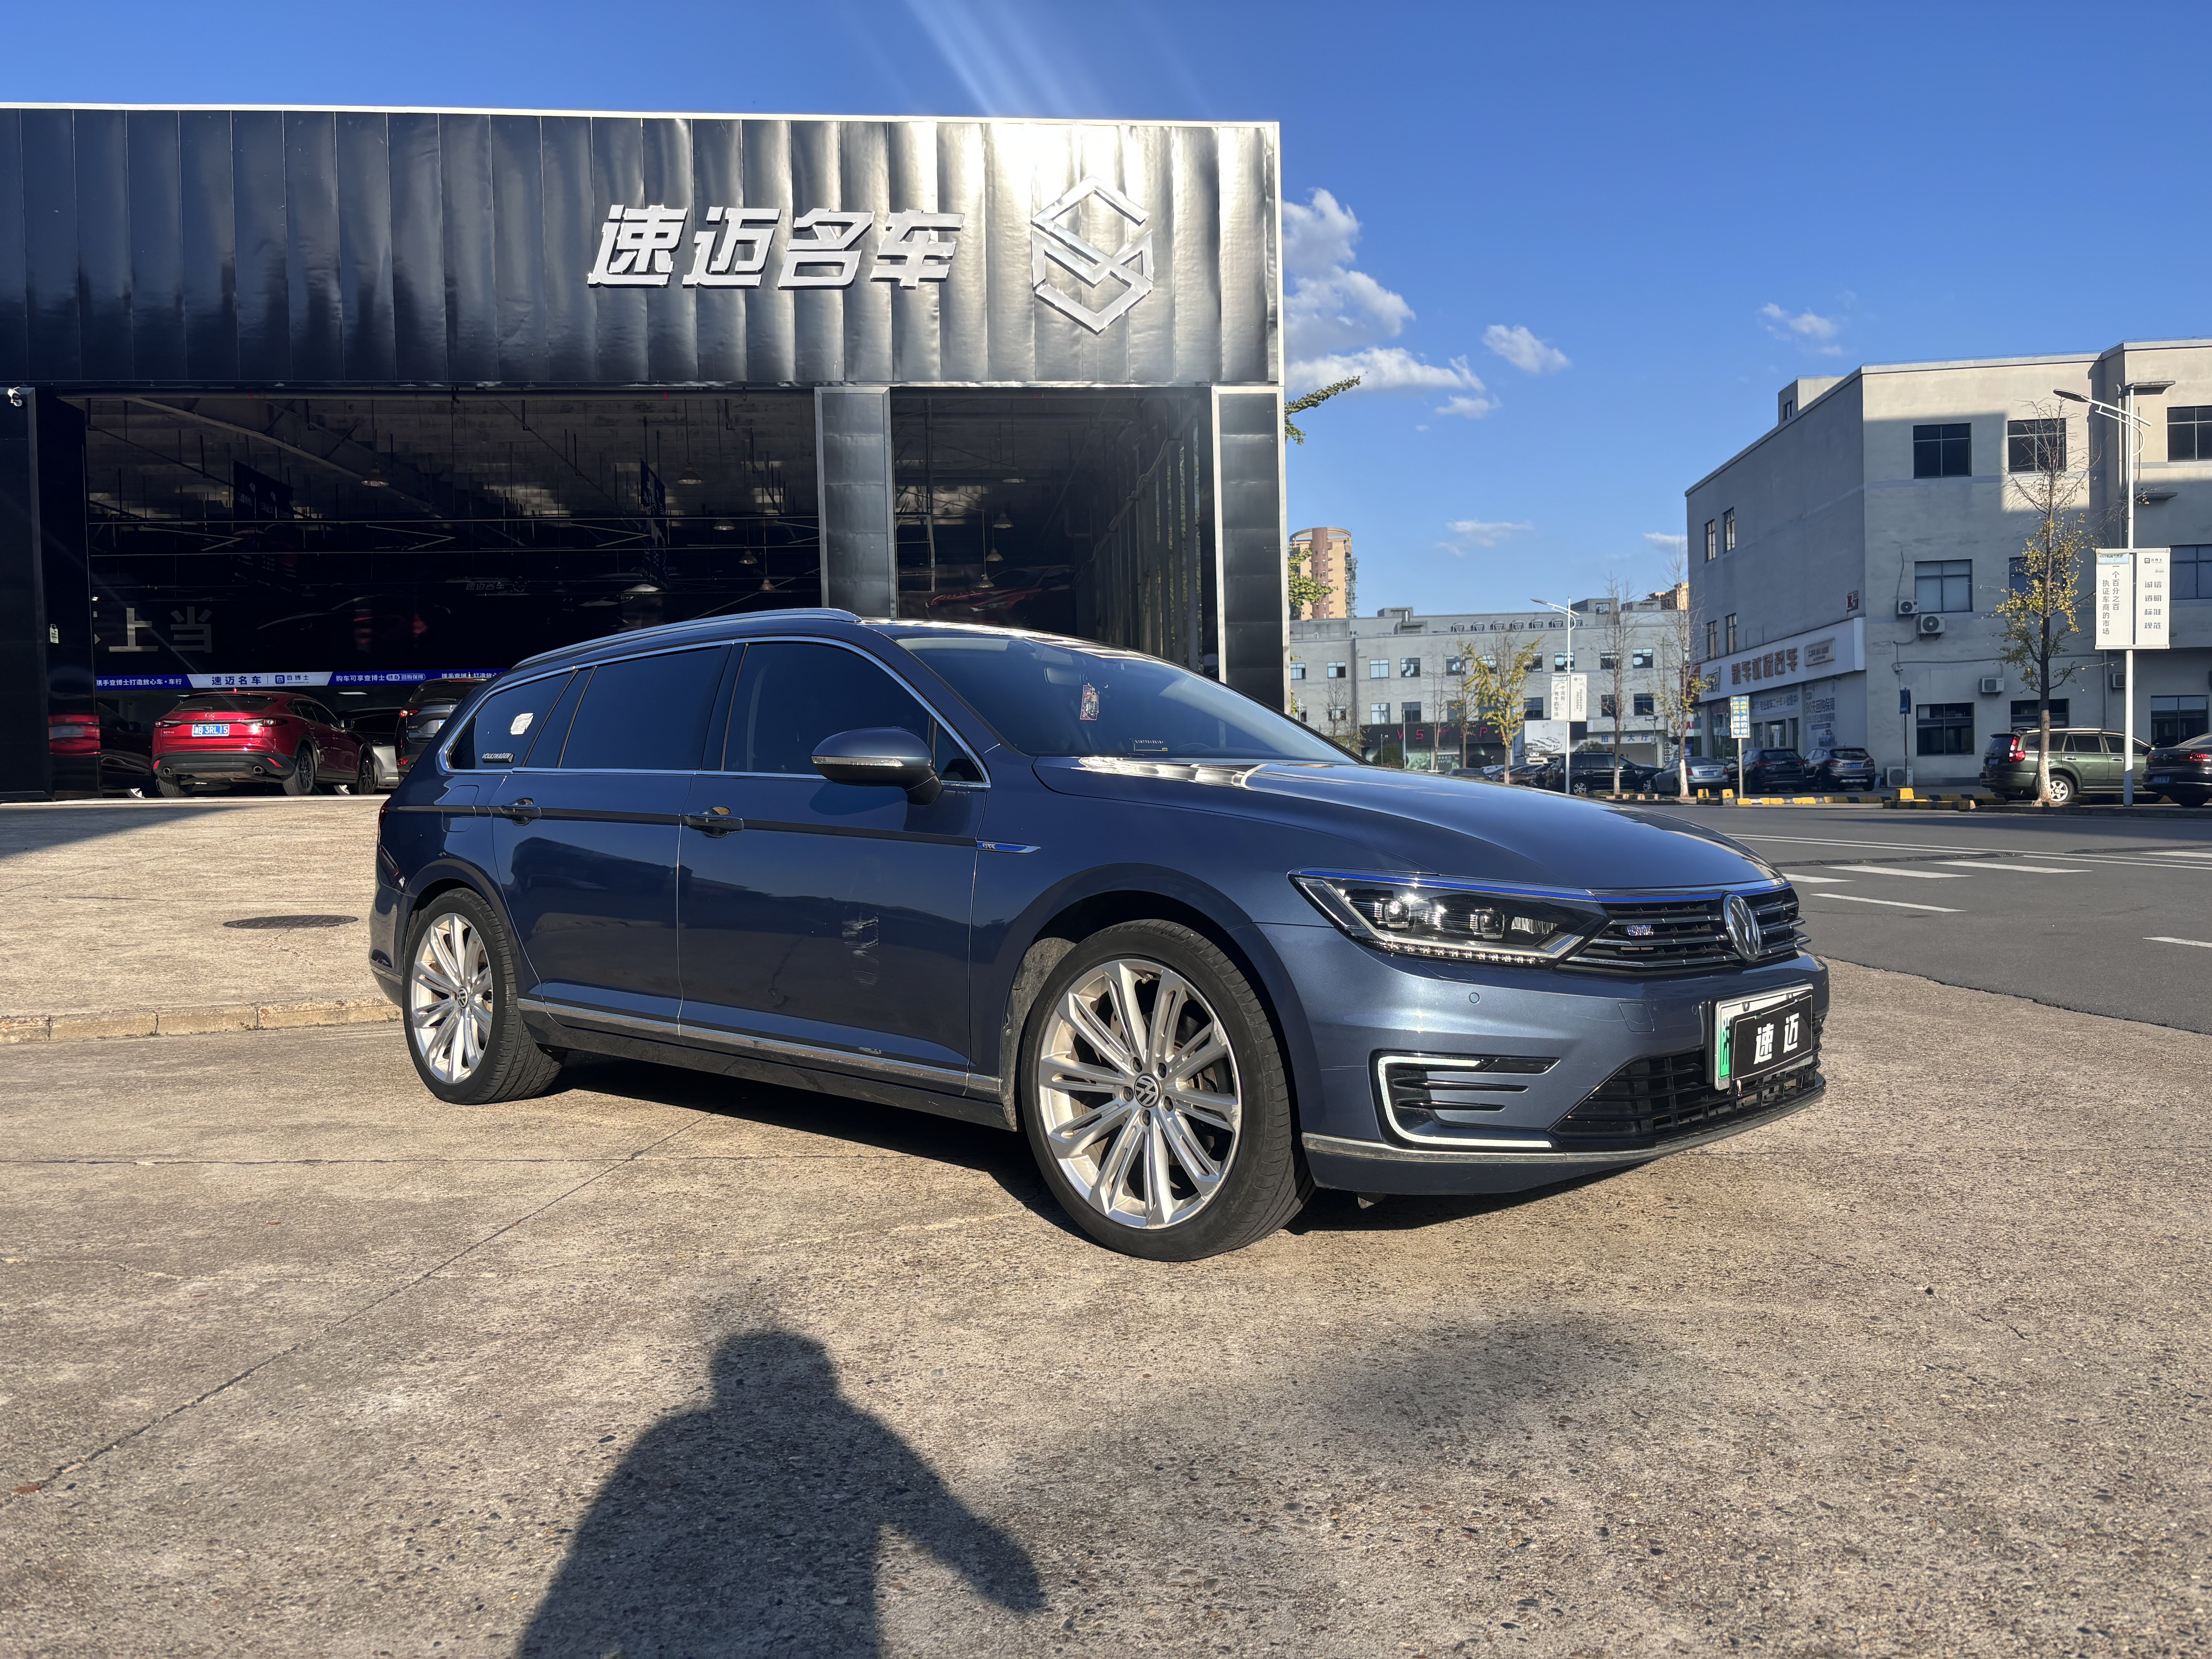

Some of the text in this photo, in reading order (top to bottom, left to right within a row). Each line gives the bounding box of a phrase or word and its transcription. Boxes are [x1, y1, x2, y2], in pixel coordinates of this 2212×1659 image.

[587, 204, 965, 288] 速迈名车
[93, 606, 212, 652] 上当
[212, 676, 261, 685] 速迈名车
[1601, 733, 1649, 742] 拍大厅
[1753, 1012, 1800, 1065] 速迈
